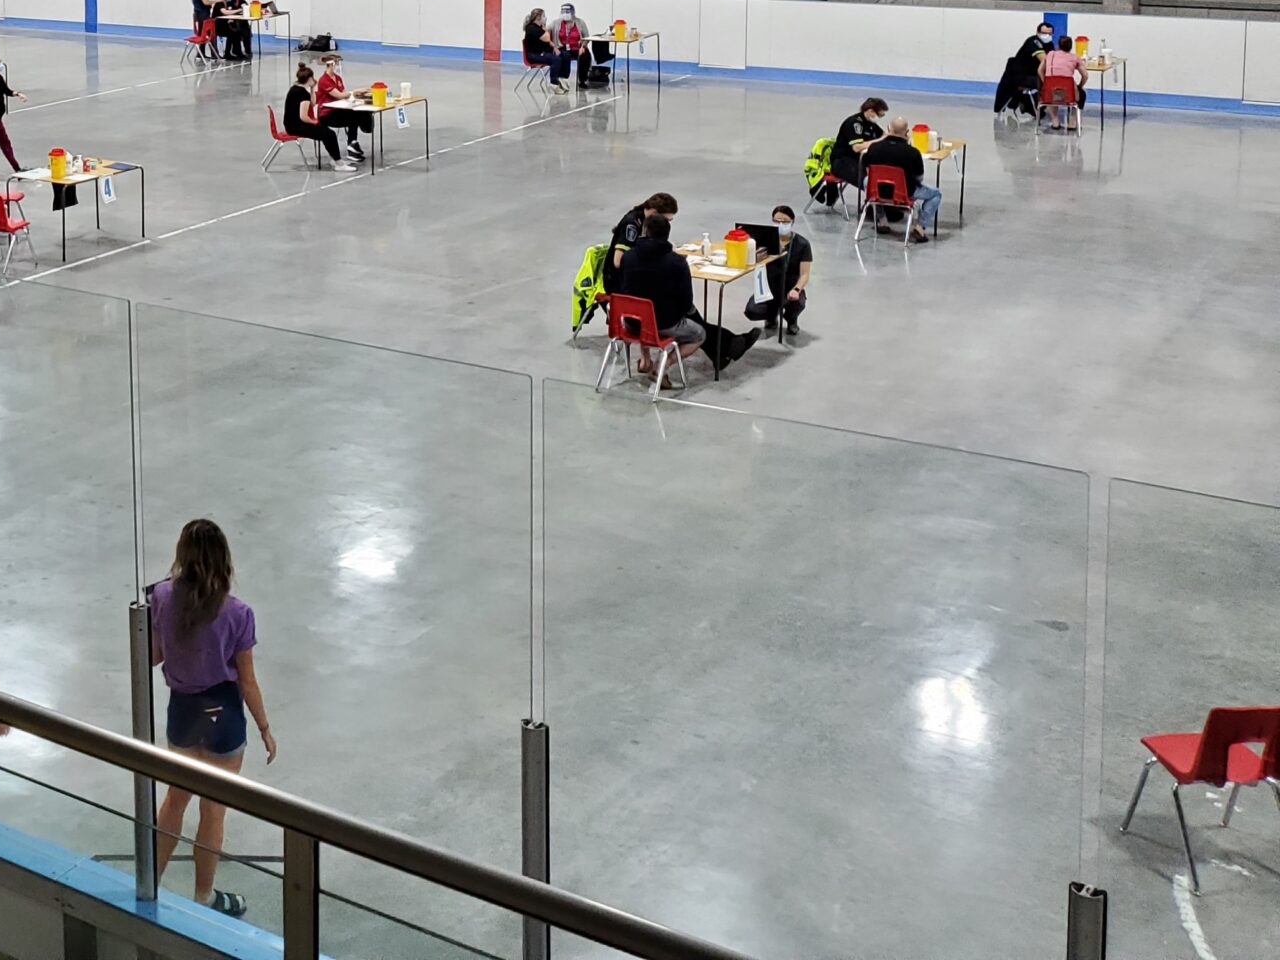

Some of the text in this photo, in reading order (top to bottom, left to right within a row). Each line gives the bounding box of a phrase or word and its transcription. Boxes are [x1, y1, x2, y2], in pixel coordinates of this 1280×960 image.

[398, 107, 405, 124] 5
[104, 177, 112, 198] 4
[757, 271, 764, 296] 1
